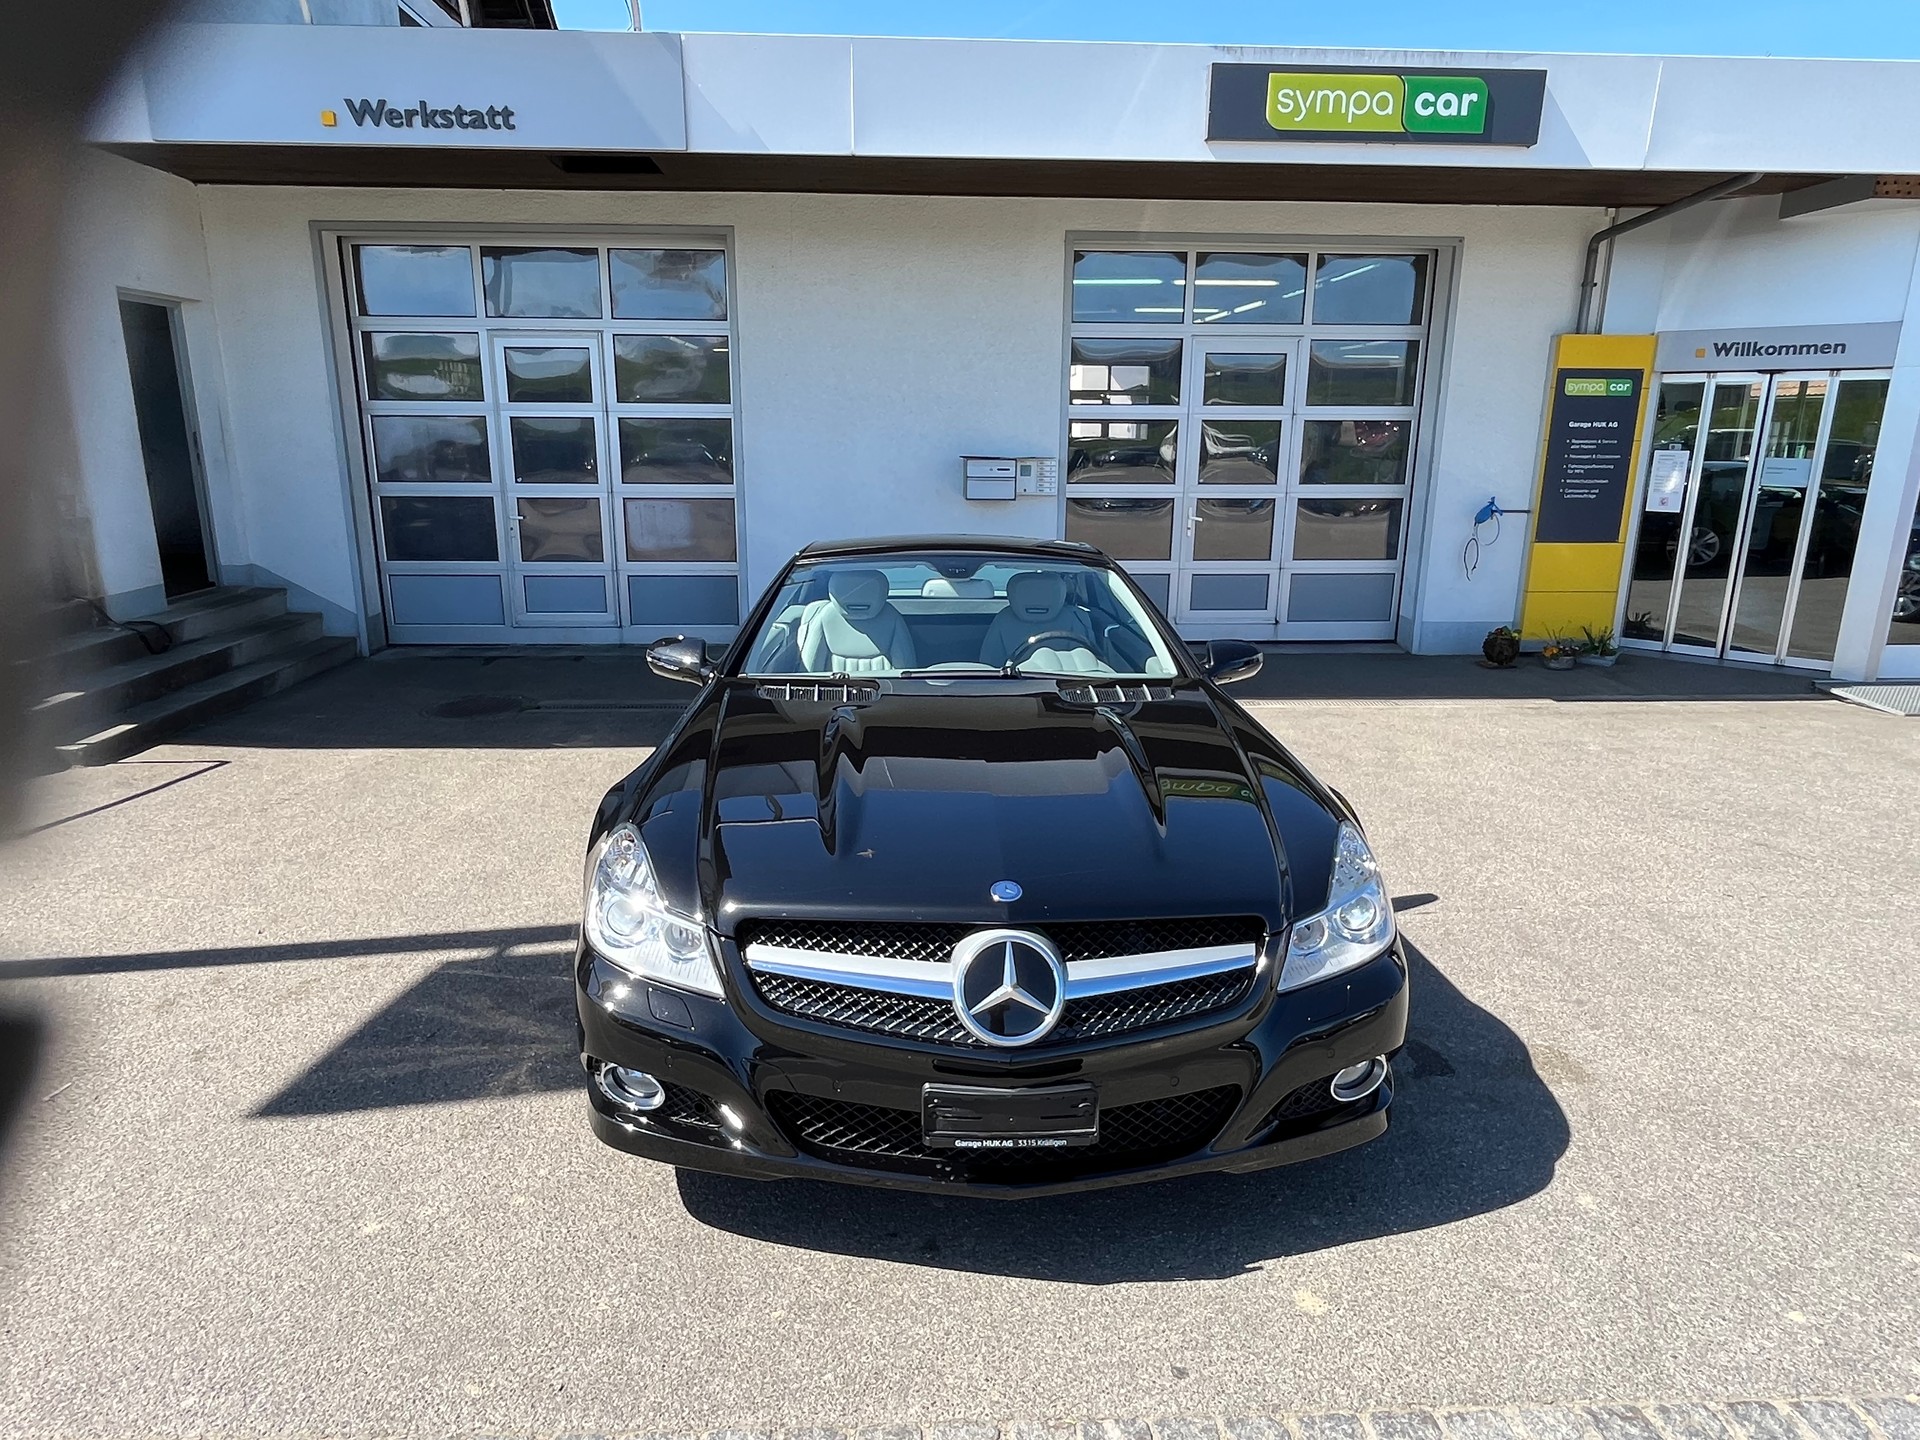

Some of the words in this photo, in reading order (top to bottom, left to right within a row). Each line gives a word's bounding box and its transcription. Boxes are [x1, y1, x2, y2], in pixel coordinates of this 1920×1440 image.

[1276, 88, 1394, 123] sympa
[1414, 91, 1479, 117] car
[343, 98, 516, 131] Werkstatt
[1713, 341, 1847, 358] Willkommen
[1567, 381, 1605, 394] sympa
[1609, 381, 1630, 392] car
[954, 1139, 982, 1149] Garage
[982, 1139, 1001, 1147] HUK
[1001, 1139, 1013, 1147] AG
[1018, 1139, 1036, 1147] 3315
